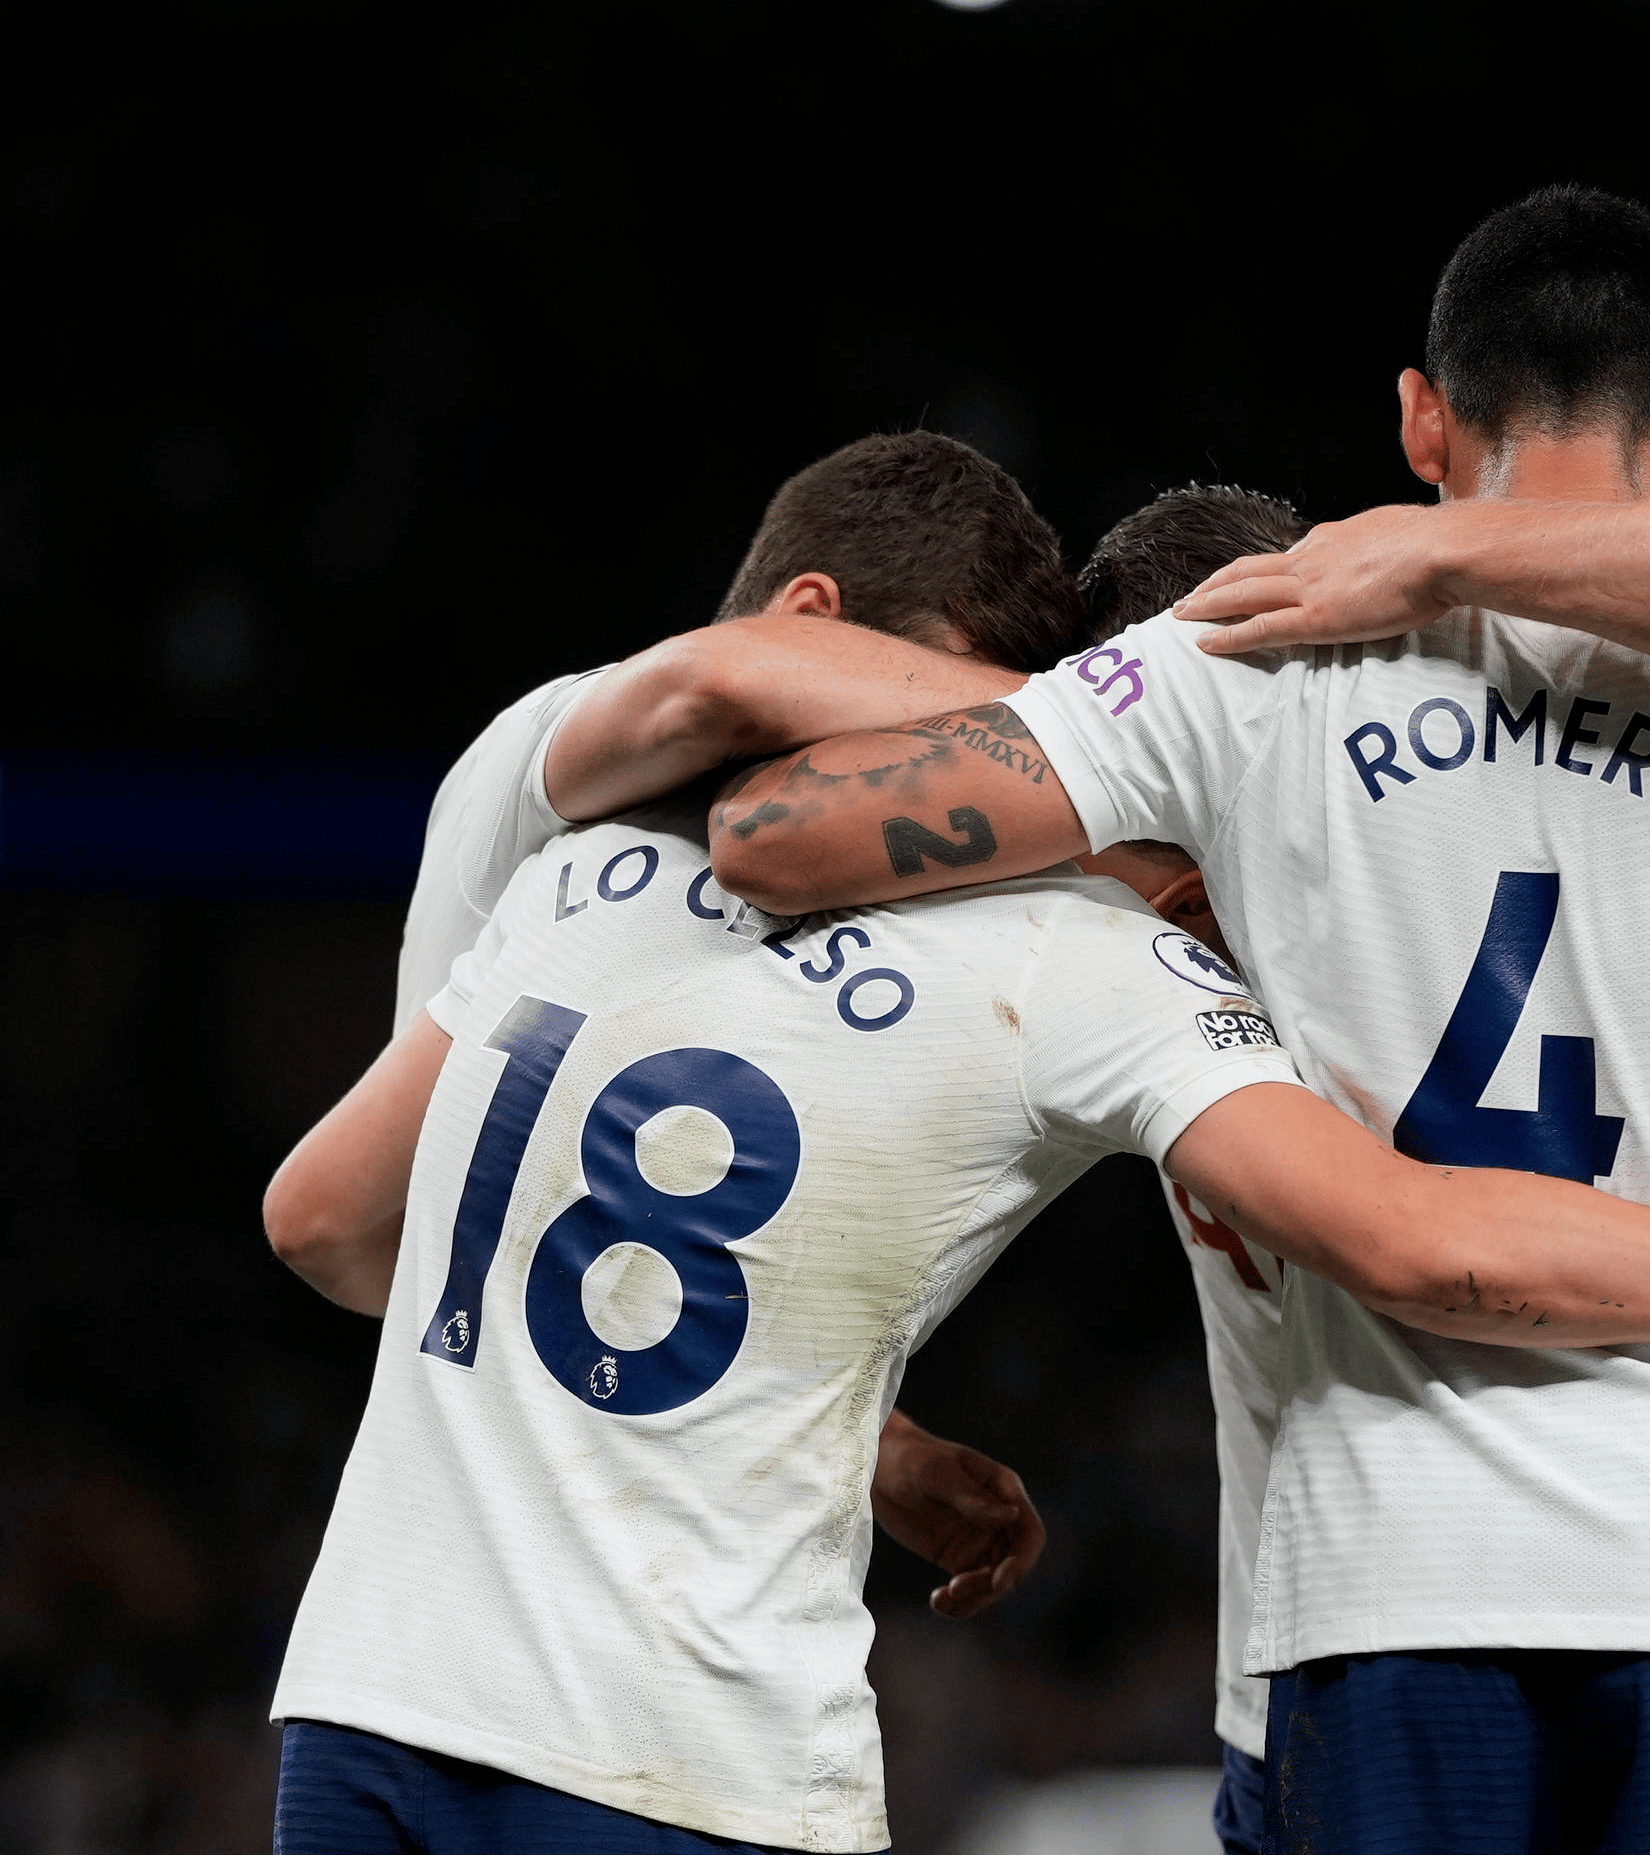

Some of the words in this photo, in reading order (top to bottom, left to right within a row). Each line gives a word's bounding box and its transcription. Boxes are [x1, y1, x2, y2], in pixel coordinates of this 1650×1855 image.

[882, 806, 998, 878] 2
[555, 845, 660, 923] LO
[1196, 1012, 1239, 1032] No
[1204, 1030, 1243, 1051] for
[1393, 871, 1625, 1187] 4
[418, 995, 800, 1416] 18
